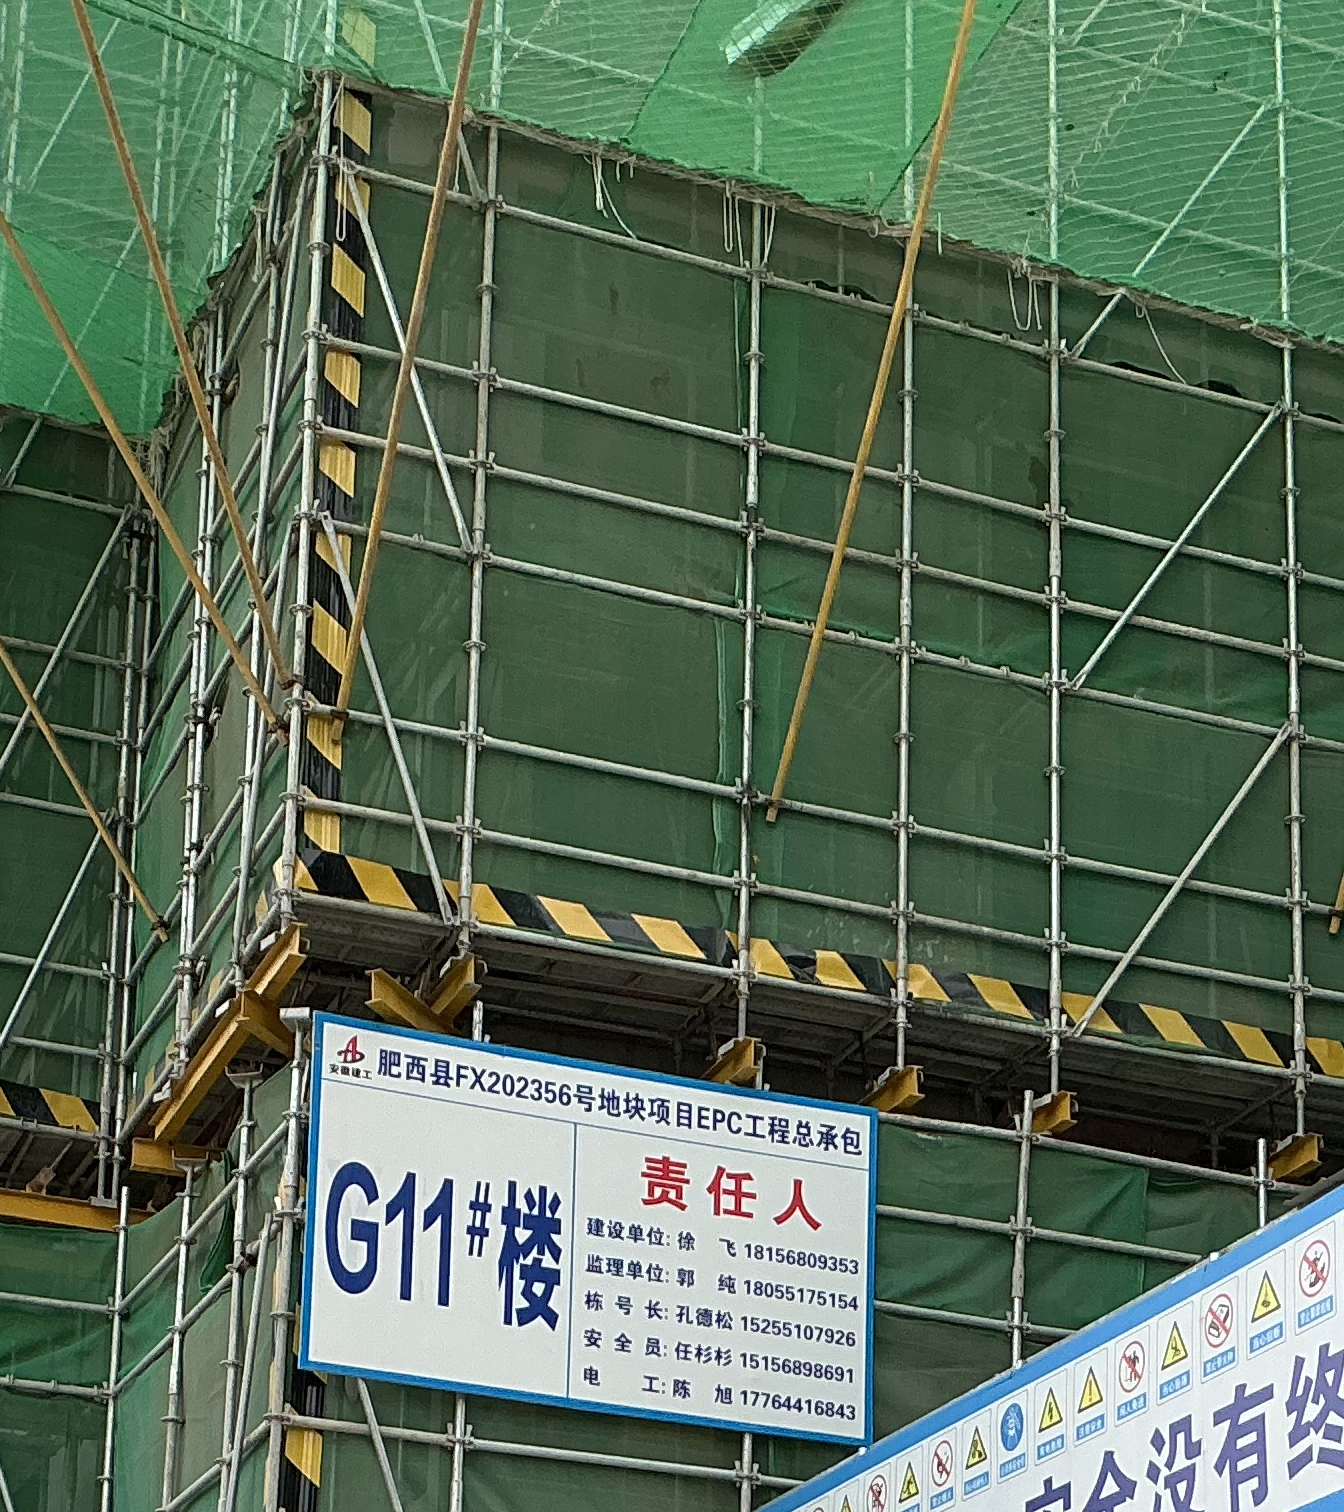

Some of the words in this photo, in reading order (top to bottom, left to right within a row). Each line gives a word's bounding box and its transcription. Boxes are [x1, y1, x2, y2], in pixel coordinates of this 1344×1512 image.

[377, 1046, 862, 1156] 肥西县FX202356号地块项目EPC工程总承包
[640, 1155, 821, 1231] 责任人
[324, 1161, 562, 1331] G11#楼
[744, 1243, 859, 1275] 18156809353
[743, 1279, 859, 1312] 18055175154
[740, 1315, 857, 1347] 15255107926
[739, 1352, 855, 1384] 15156898691
[739, 1389, 857, 1421] 17764416843
